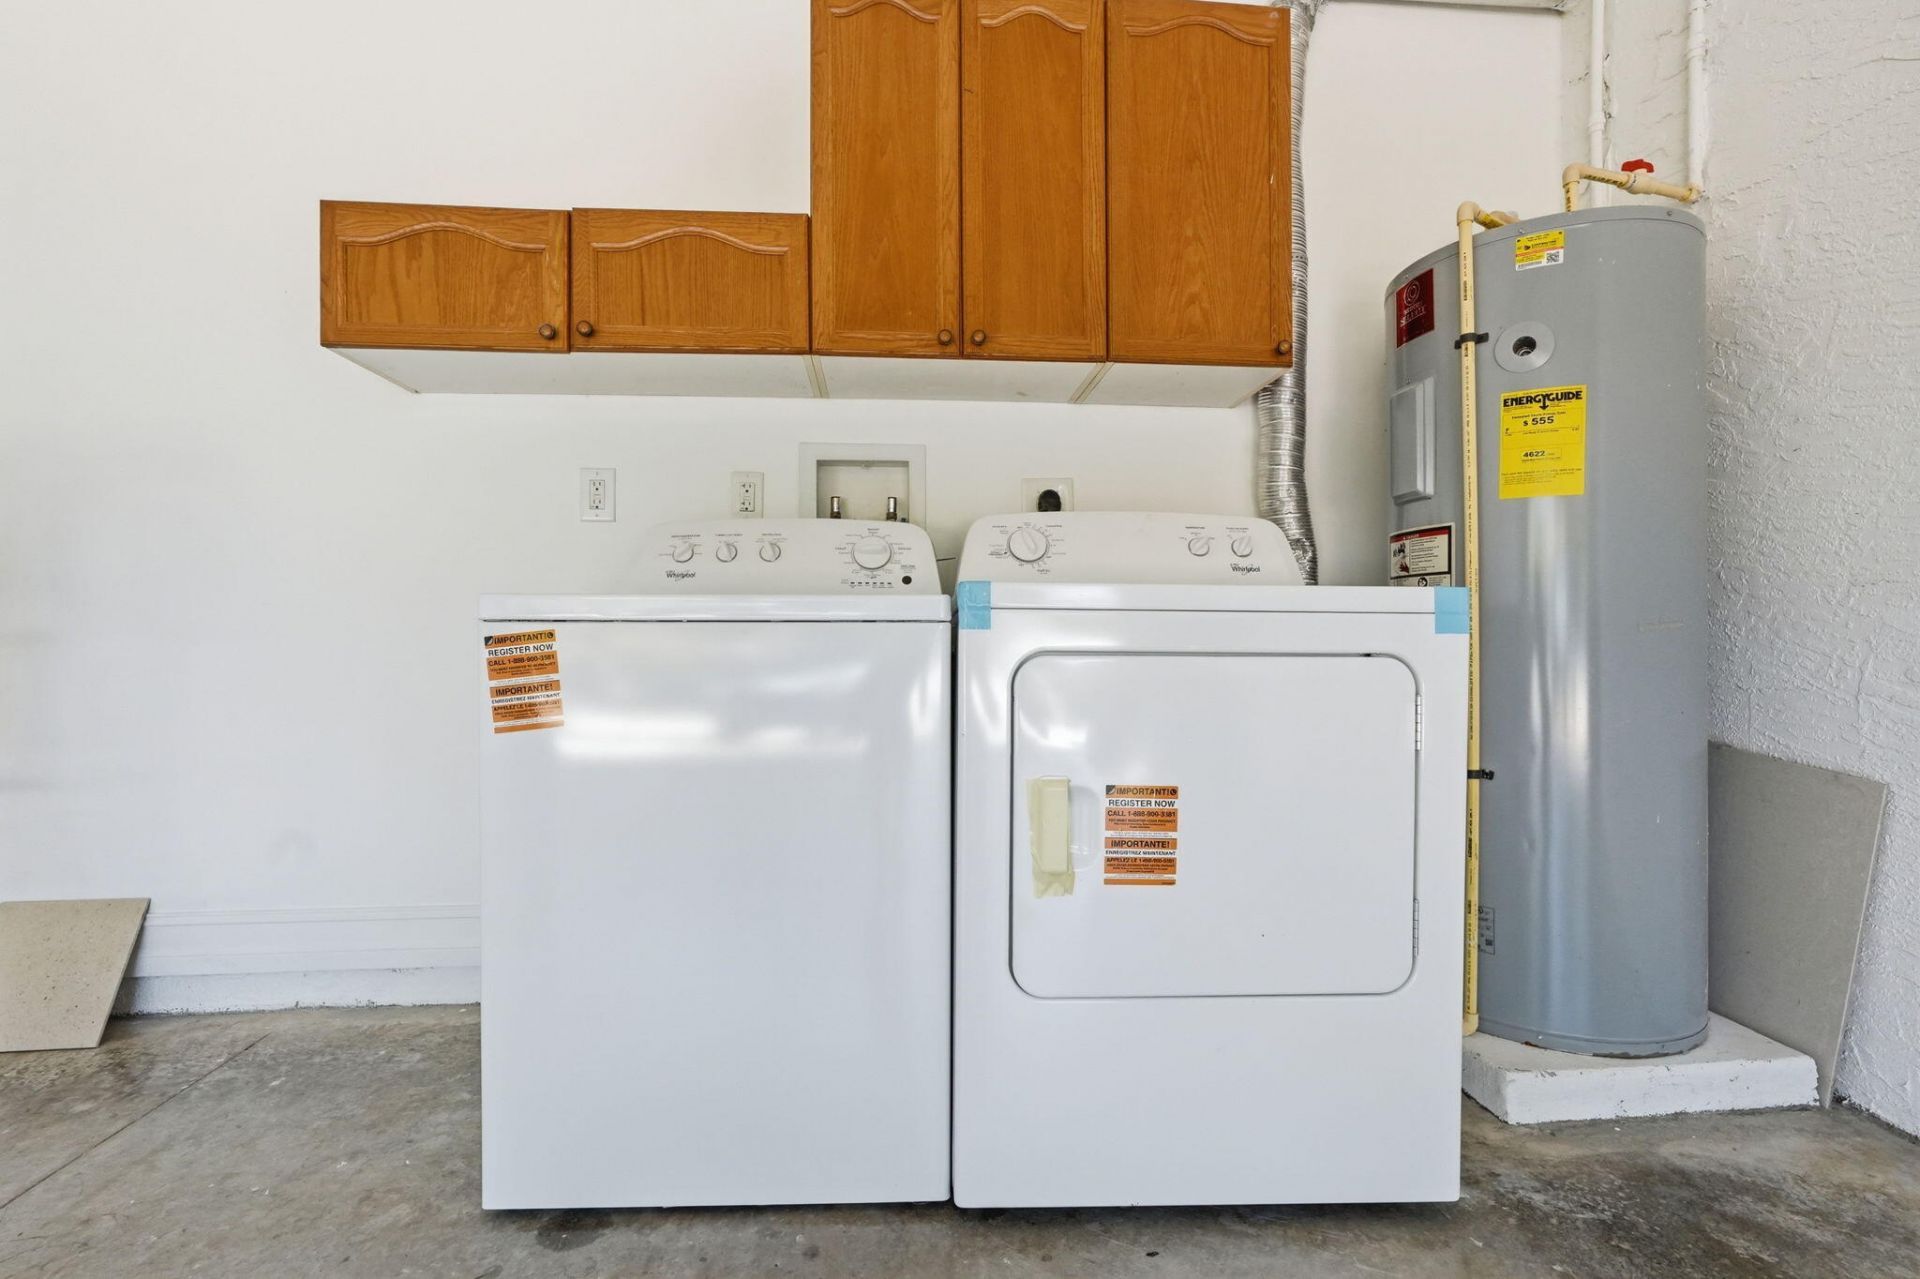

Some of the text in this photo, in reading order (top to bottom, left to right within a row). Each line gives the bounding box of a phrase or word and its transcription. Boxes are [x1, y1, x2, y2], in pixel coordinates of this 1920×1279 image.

[1531, 415, 1555, 426] 555
[1523, 450, 1546, 458] 4622
[1230, 565, 1261, 574] Whirlpool
[665, 571, 696, 580] Whirlpool
[488, 643, 554, 657] REGISTER NOW
[488, 658, 506, 667] CALL
[496, 684, 553, 697] IMPORTANTE!
[1108, 799, 1176, 808] REGISTER NOW
[1111, 840, 1170, 849] IMPORTANTE!
